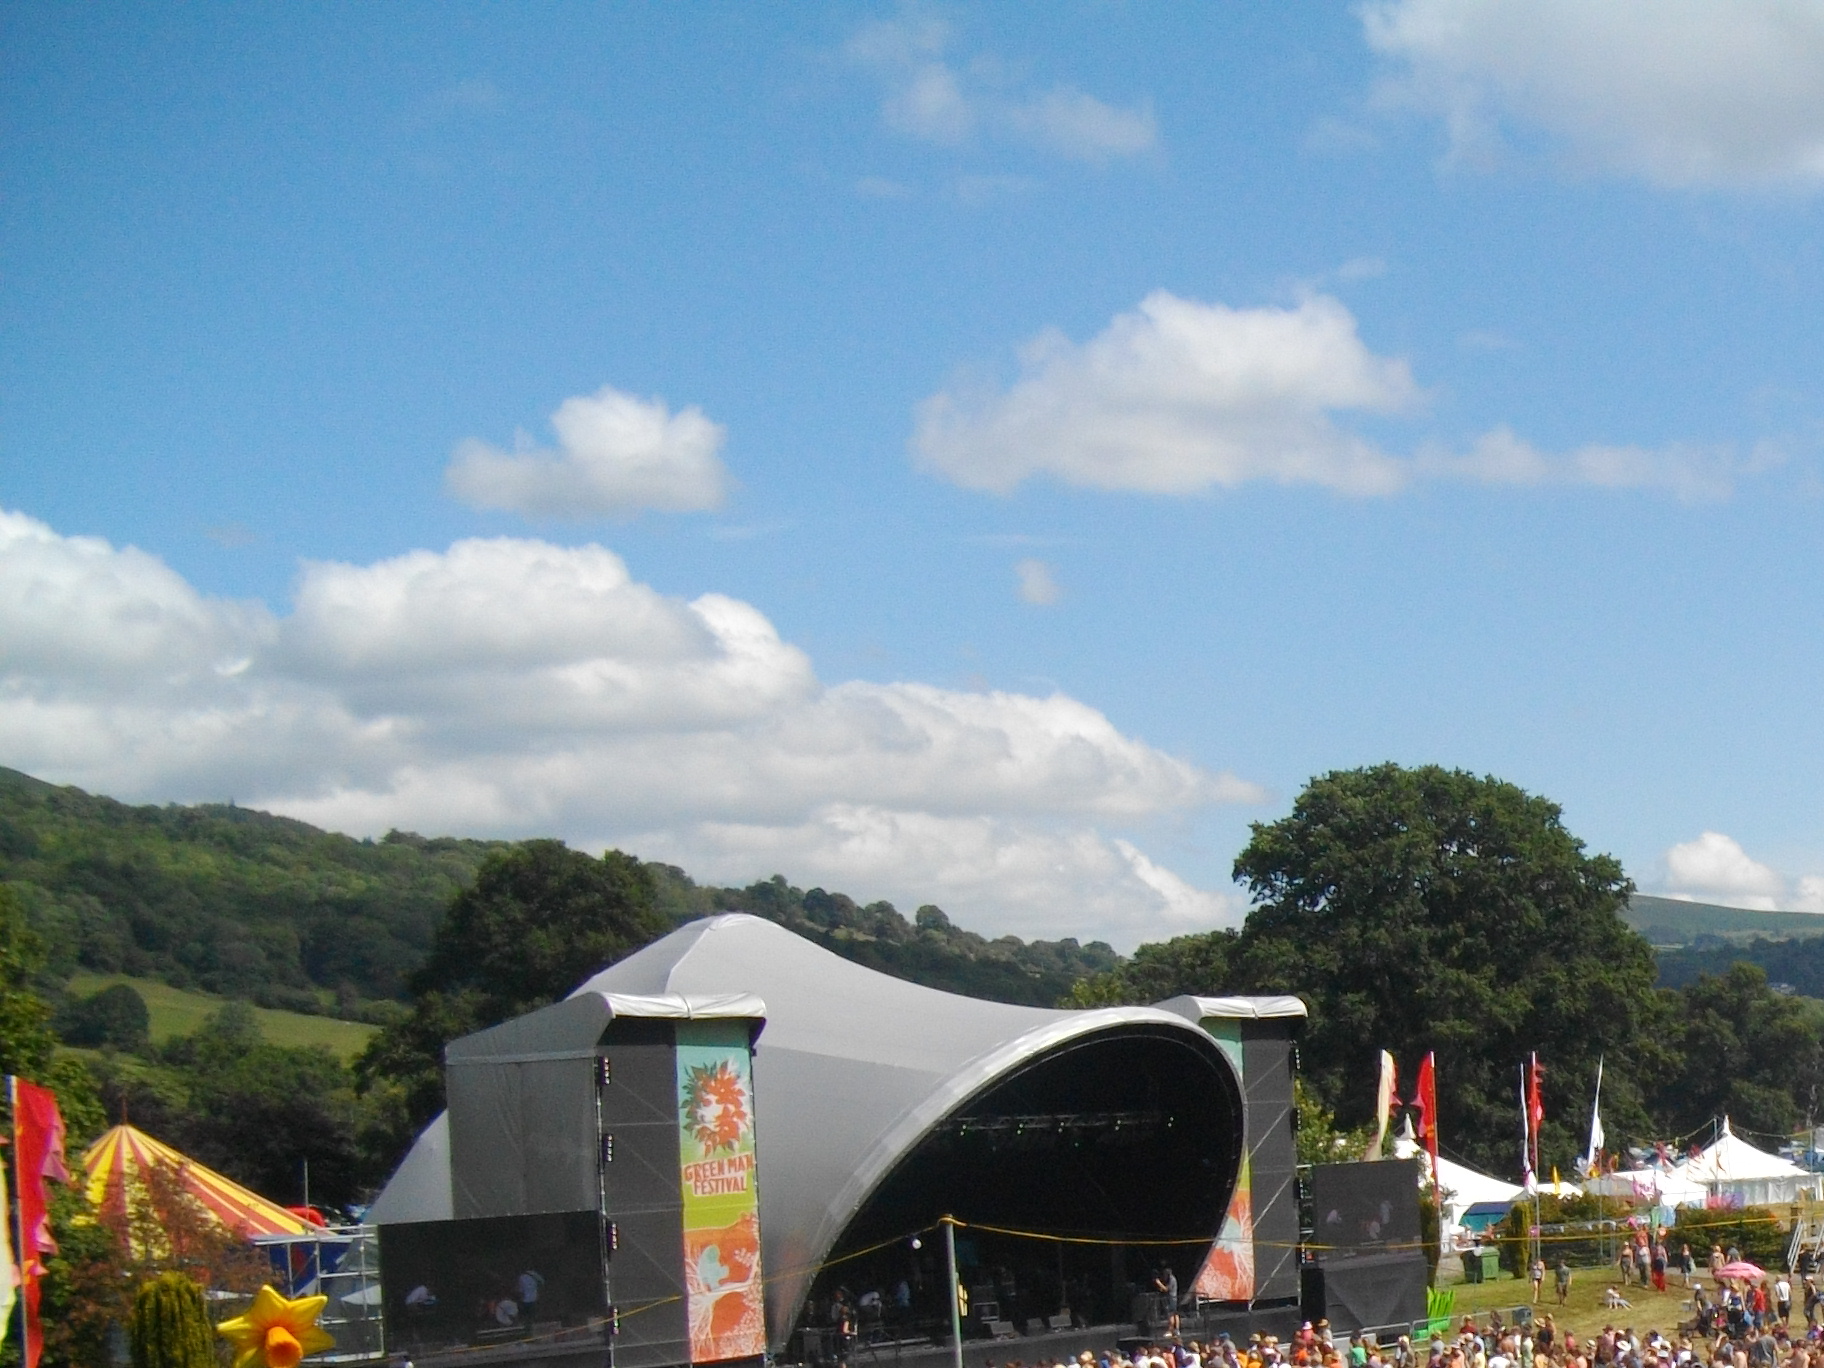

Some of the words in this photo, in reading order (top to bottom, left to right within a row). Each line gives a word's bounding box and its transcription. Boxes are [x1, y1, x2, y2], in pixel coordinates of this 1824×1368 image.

[684, 1159, 725, 1182] GREEN
[728, 1153, 754, 1173] MAN
[694, 1176, 747, 1195] FESTIVAL
